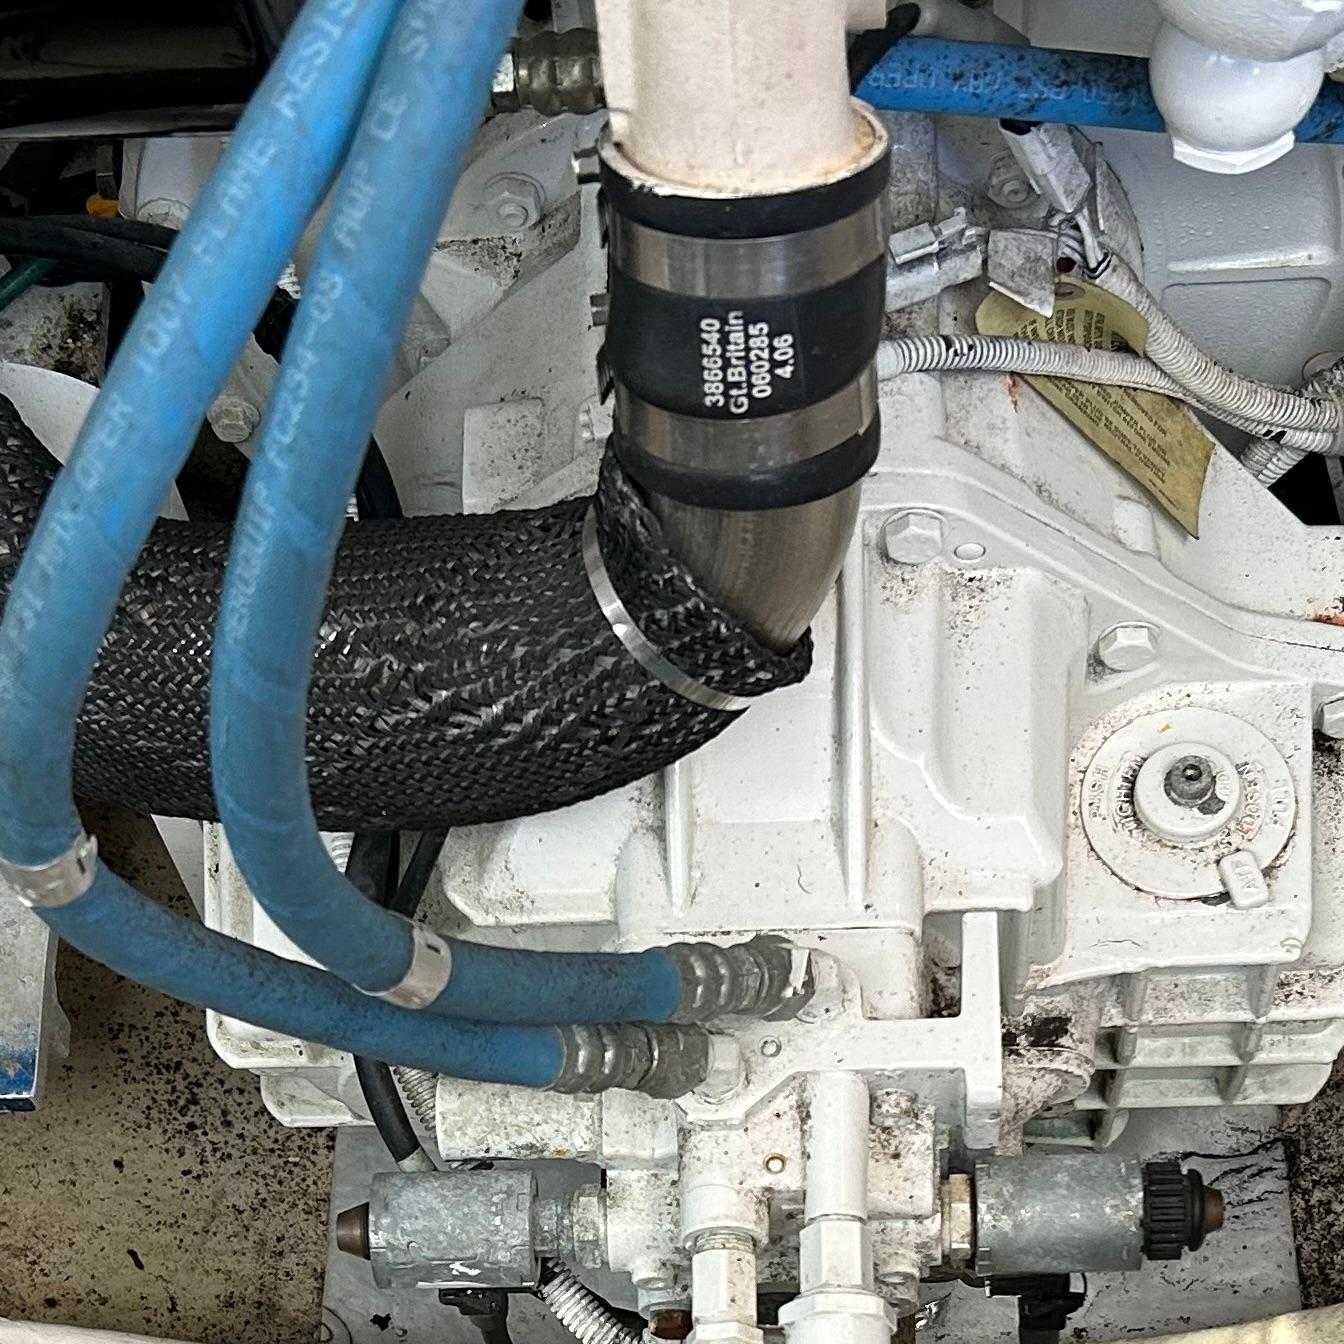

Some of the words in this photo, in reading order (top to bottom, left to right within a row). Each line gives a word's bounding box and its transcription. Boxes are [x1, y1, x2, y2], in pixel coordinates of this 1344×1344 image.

[190, 138, 278, 264] FLAME
[700, 317, 725, 407] 3866540
[724, 310, 749, 414] Gt.Britain
[772, 333, 795, 379] 4.06
